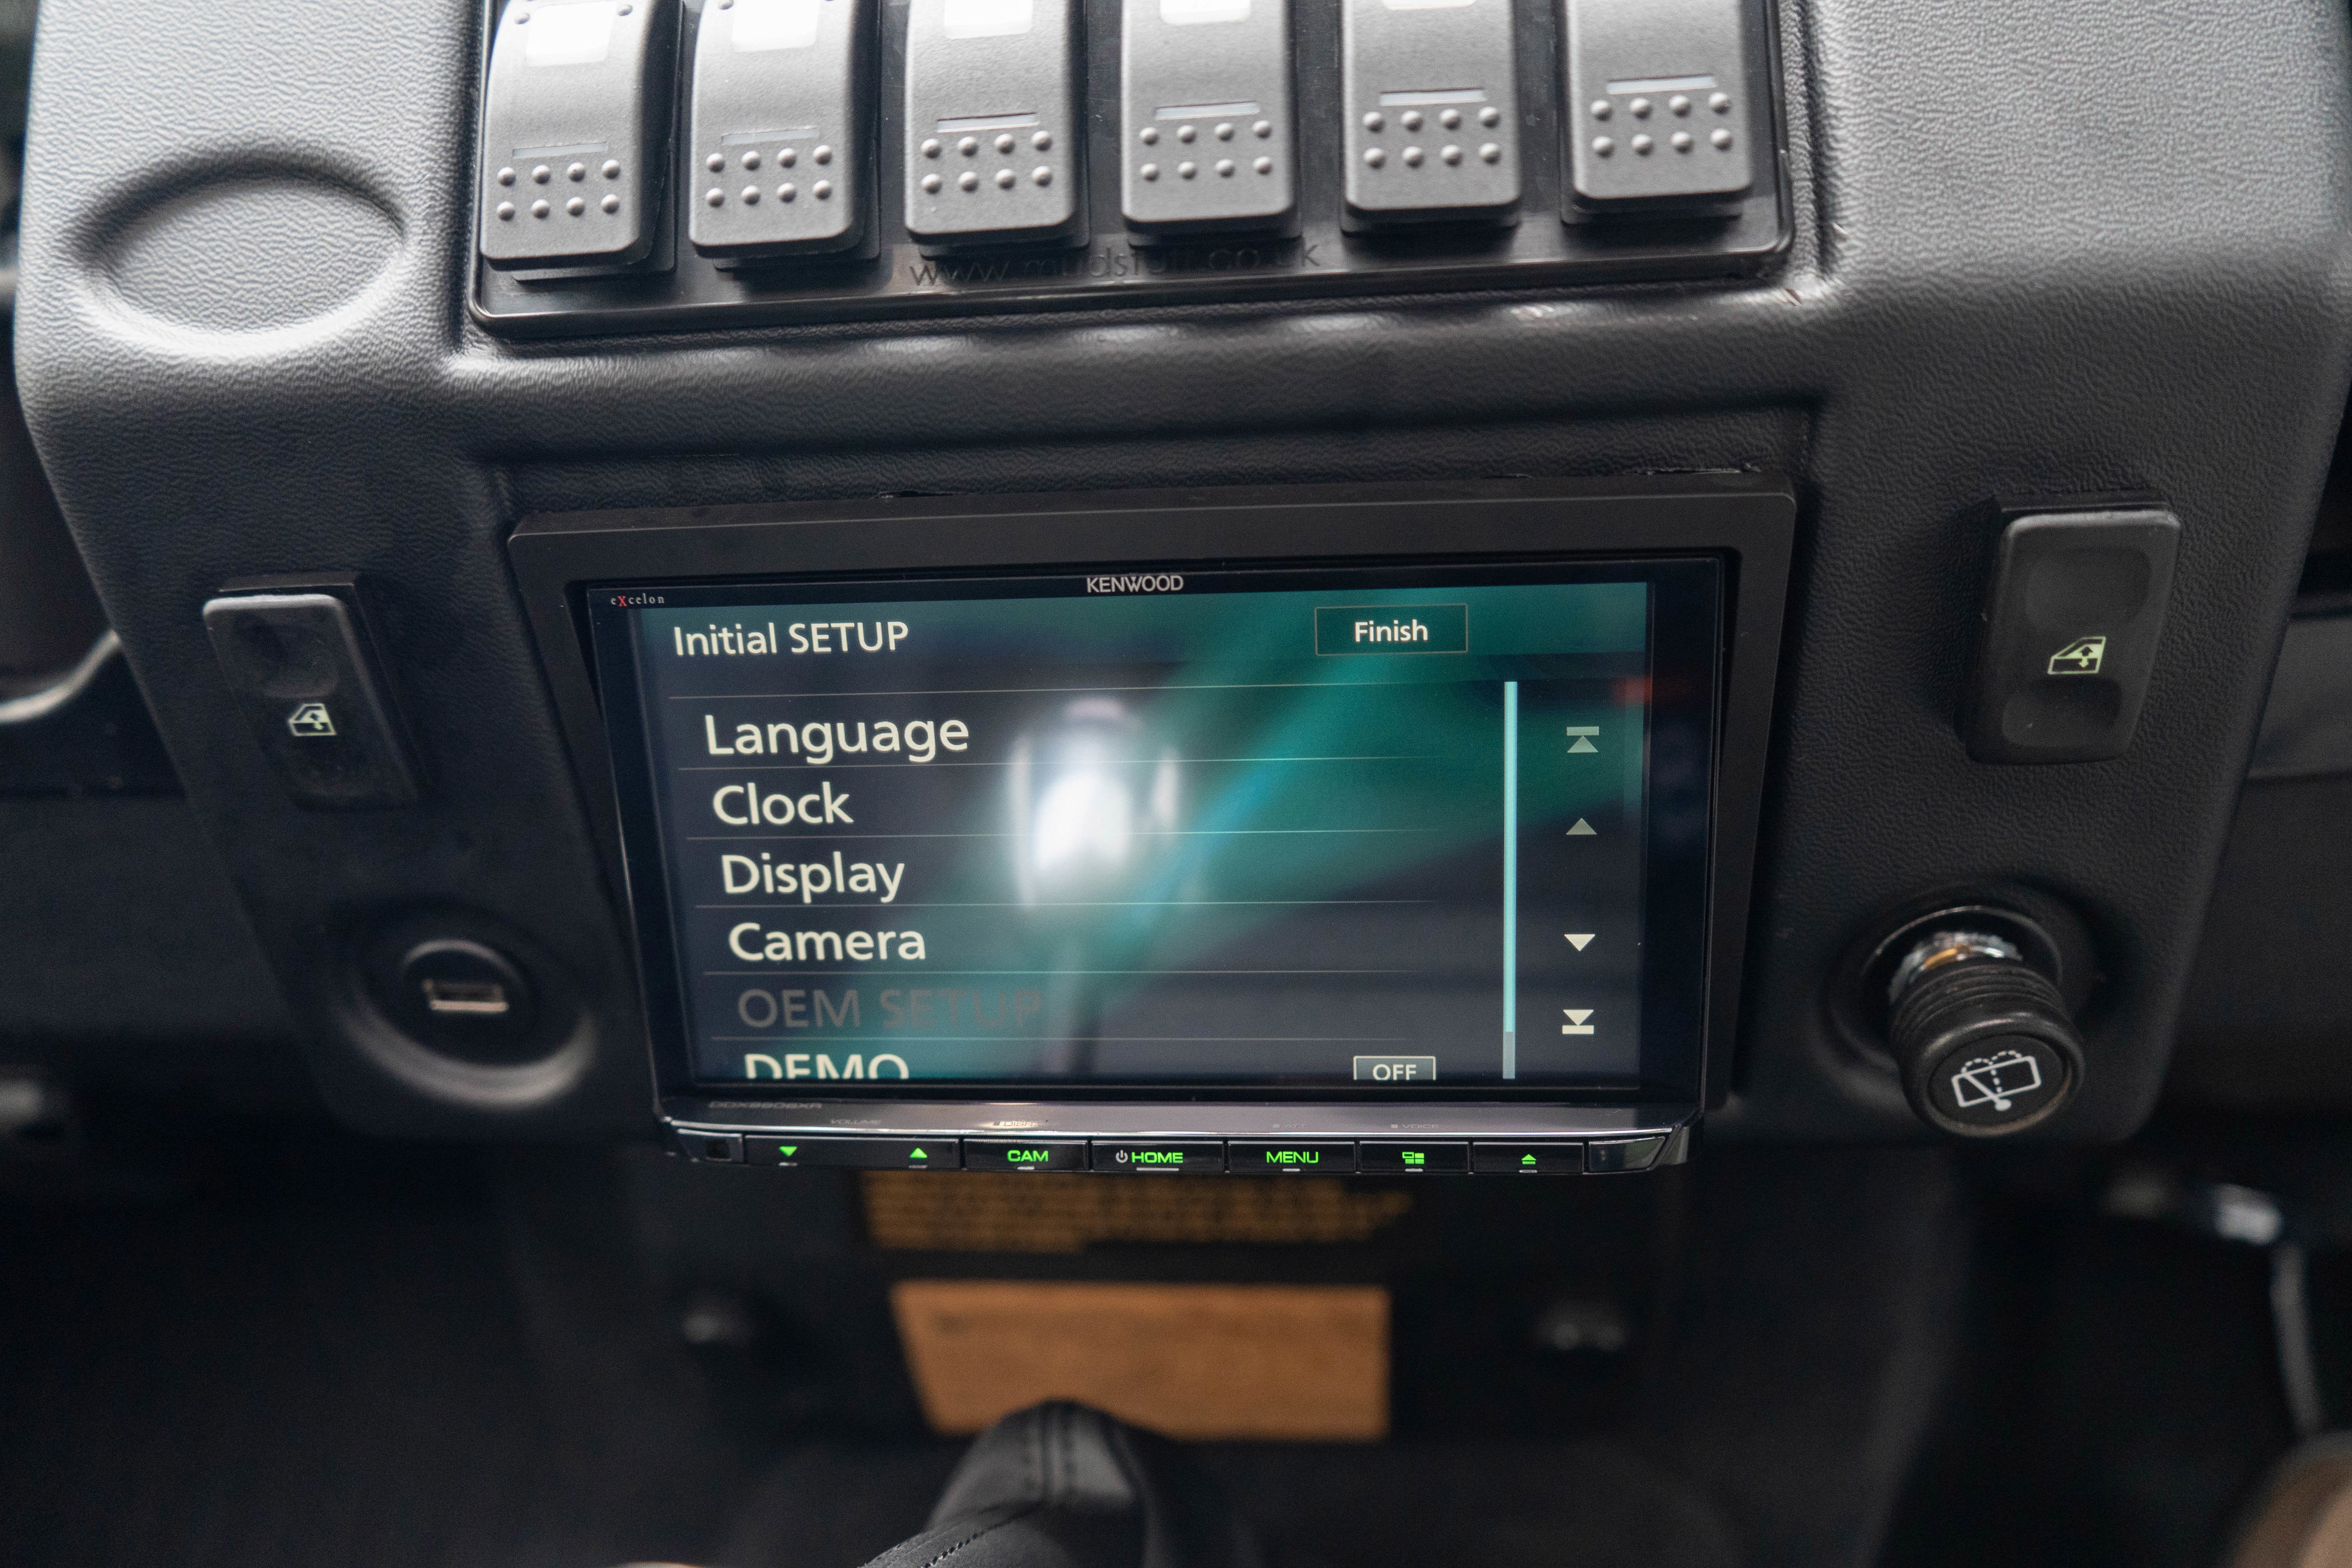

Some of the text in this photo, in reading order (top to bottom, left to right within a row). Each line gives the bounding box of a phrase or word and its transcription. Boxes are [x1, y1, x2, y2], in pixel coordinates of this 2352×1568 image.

[1087, 575, 1184, 593] KENWOOD
[610, 593, 665, 607] eXcelon
[674, 621, 909, 656] Initial SETUP
[1354, 619, 1428, 642] Finish
[705, 715, 969, 764] Language
[713, 782, 854, 824] Clock
[721, 851, 905, 904] Display
[728, 922, 926, 960] Camera
[738, 989, 1042, 1028] OEM SETUP
[744, 1054, 909, 1079] DEMO
[1372, 1063, 1417, 1080] OFF
[1007, 1149, 1049, 1162] CAM
[1131, 1152, 1183, 1164] HOME
[1266, 1151, 1319, 1164] MENU
